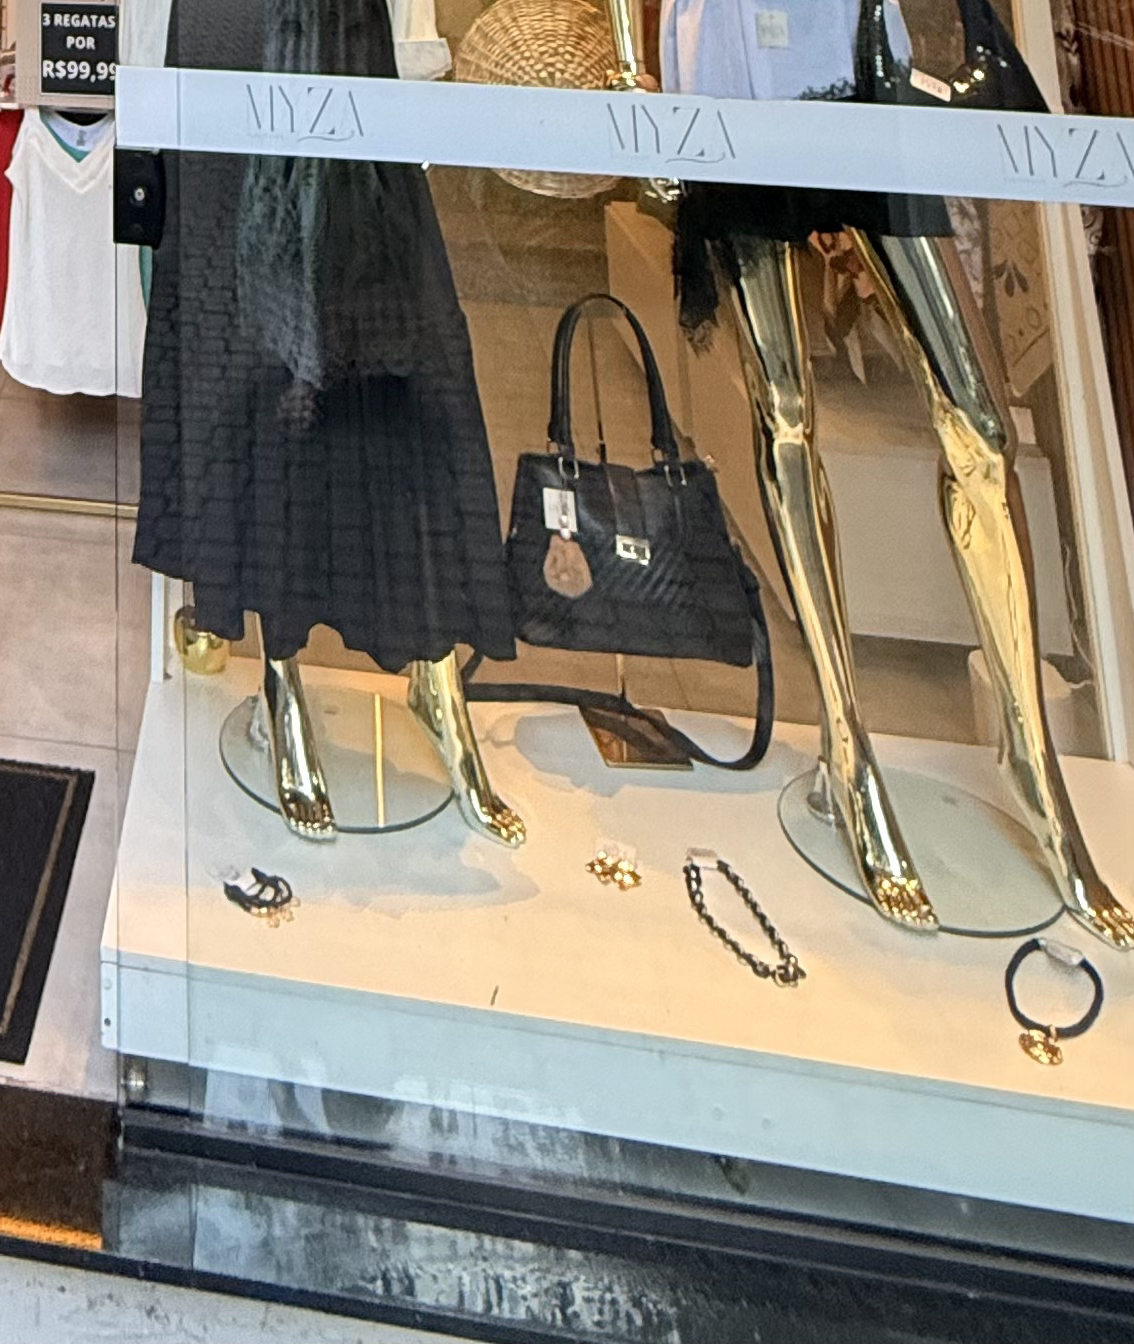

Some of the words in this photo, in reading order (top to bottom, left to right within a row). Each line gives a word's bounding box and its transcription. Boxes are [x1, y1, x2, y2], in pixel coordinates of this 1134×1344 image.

[42, 13, 51, 26] 3
[54, 13, 116, 29] REGATAS
[66, 35, 96, 50] POR
[245, 84, 364, 137] MYZA
[606, 102, 736, 160] MYZA
